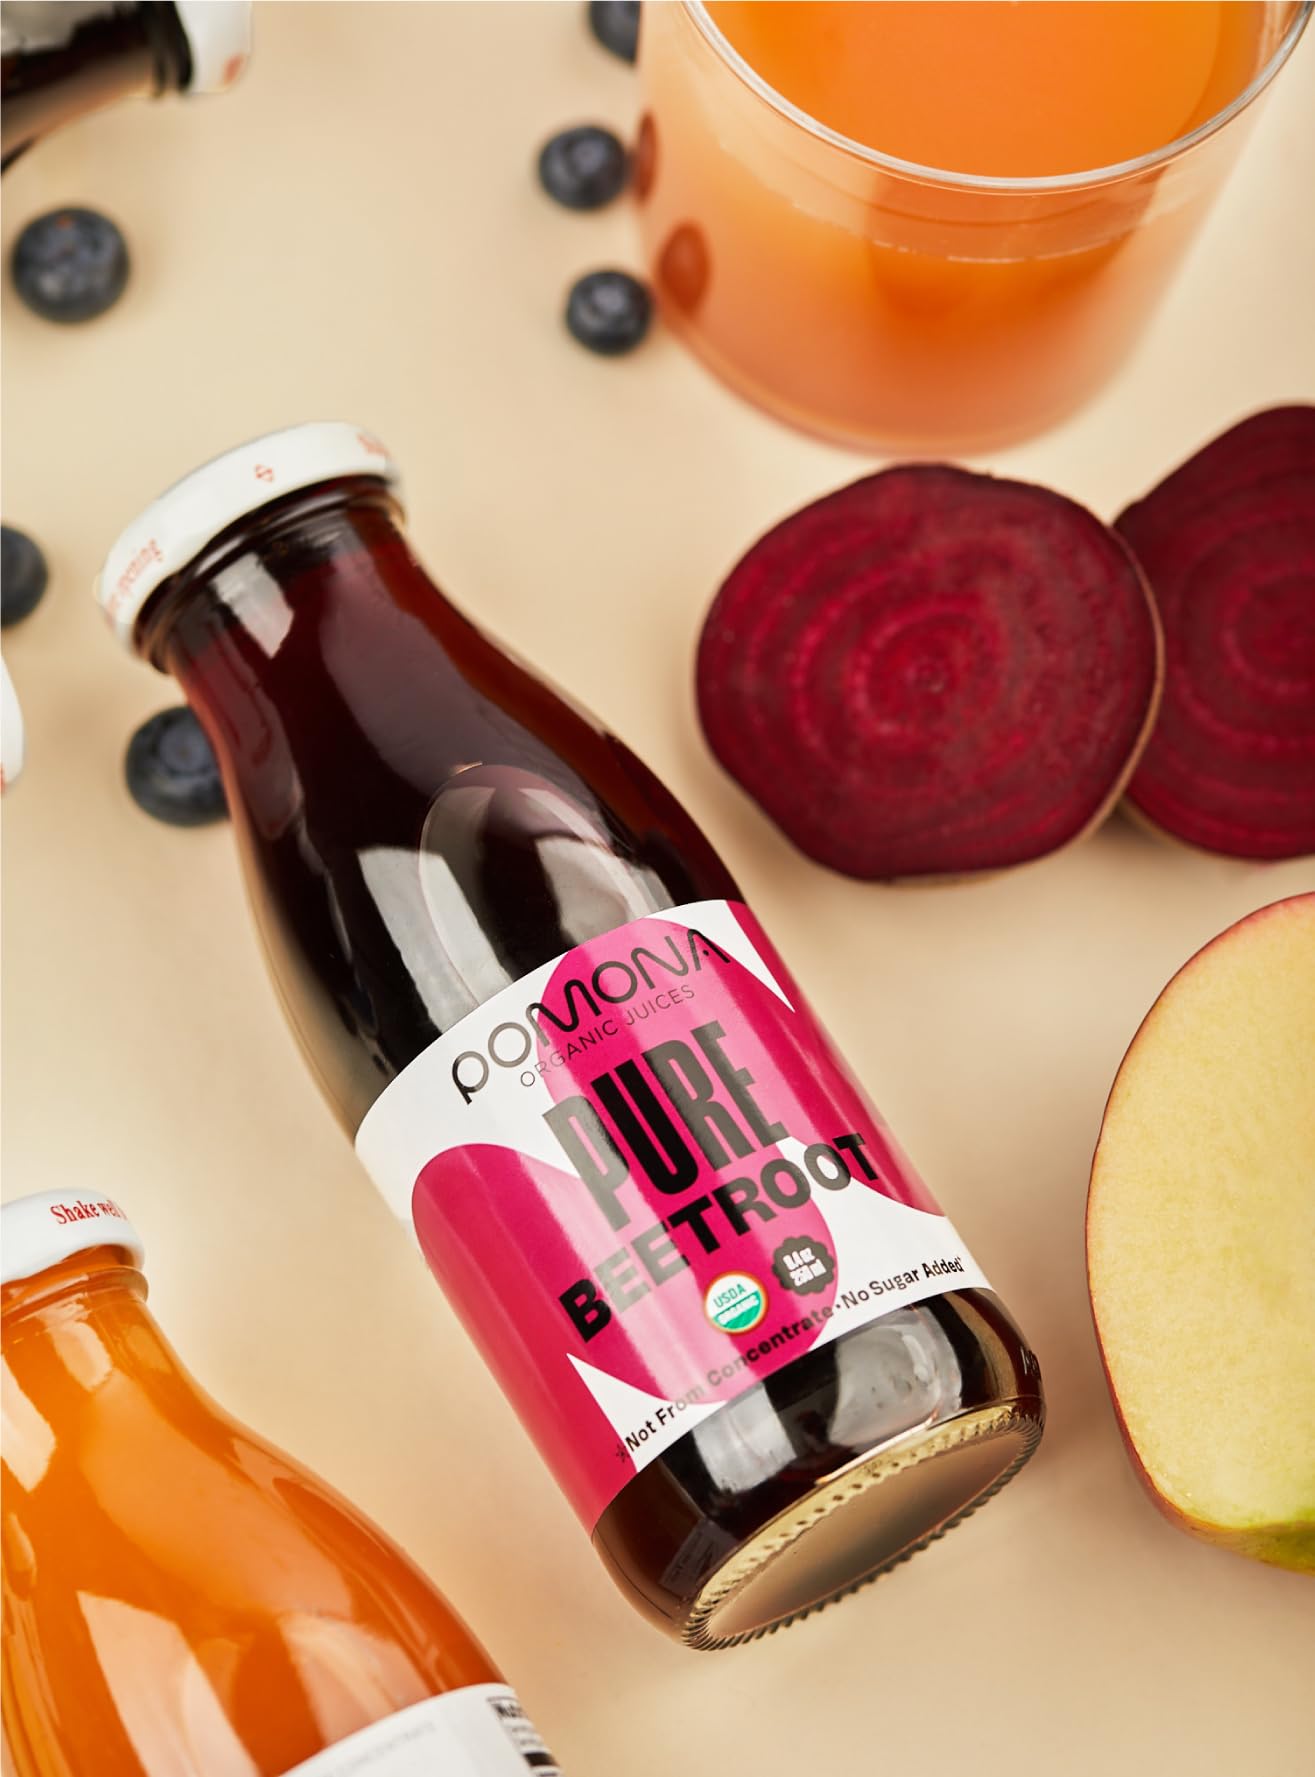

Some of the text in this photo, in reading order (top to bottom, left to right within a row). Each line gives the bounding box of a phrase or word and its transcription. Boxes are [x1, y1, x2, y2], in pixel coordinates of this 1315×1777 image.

[452, 928, 731, 1105] POMONA
[520, 985, 695, 1087] ORGANIC JUICES
[542, 1020, 790, 1231] PURE
[50, 1200, 100, 1224] Shake
[558, 1133, 879, 1343] BEETROOT
[655, 1382, 706, 1426] From
[707, 1305, 834, 1387] Concentrate
[841, 1288, 870, 1310] No
[869, 1268, 921, 1297] Sugar
[713, 1283, 747, 1309] USDA
